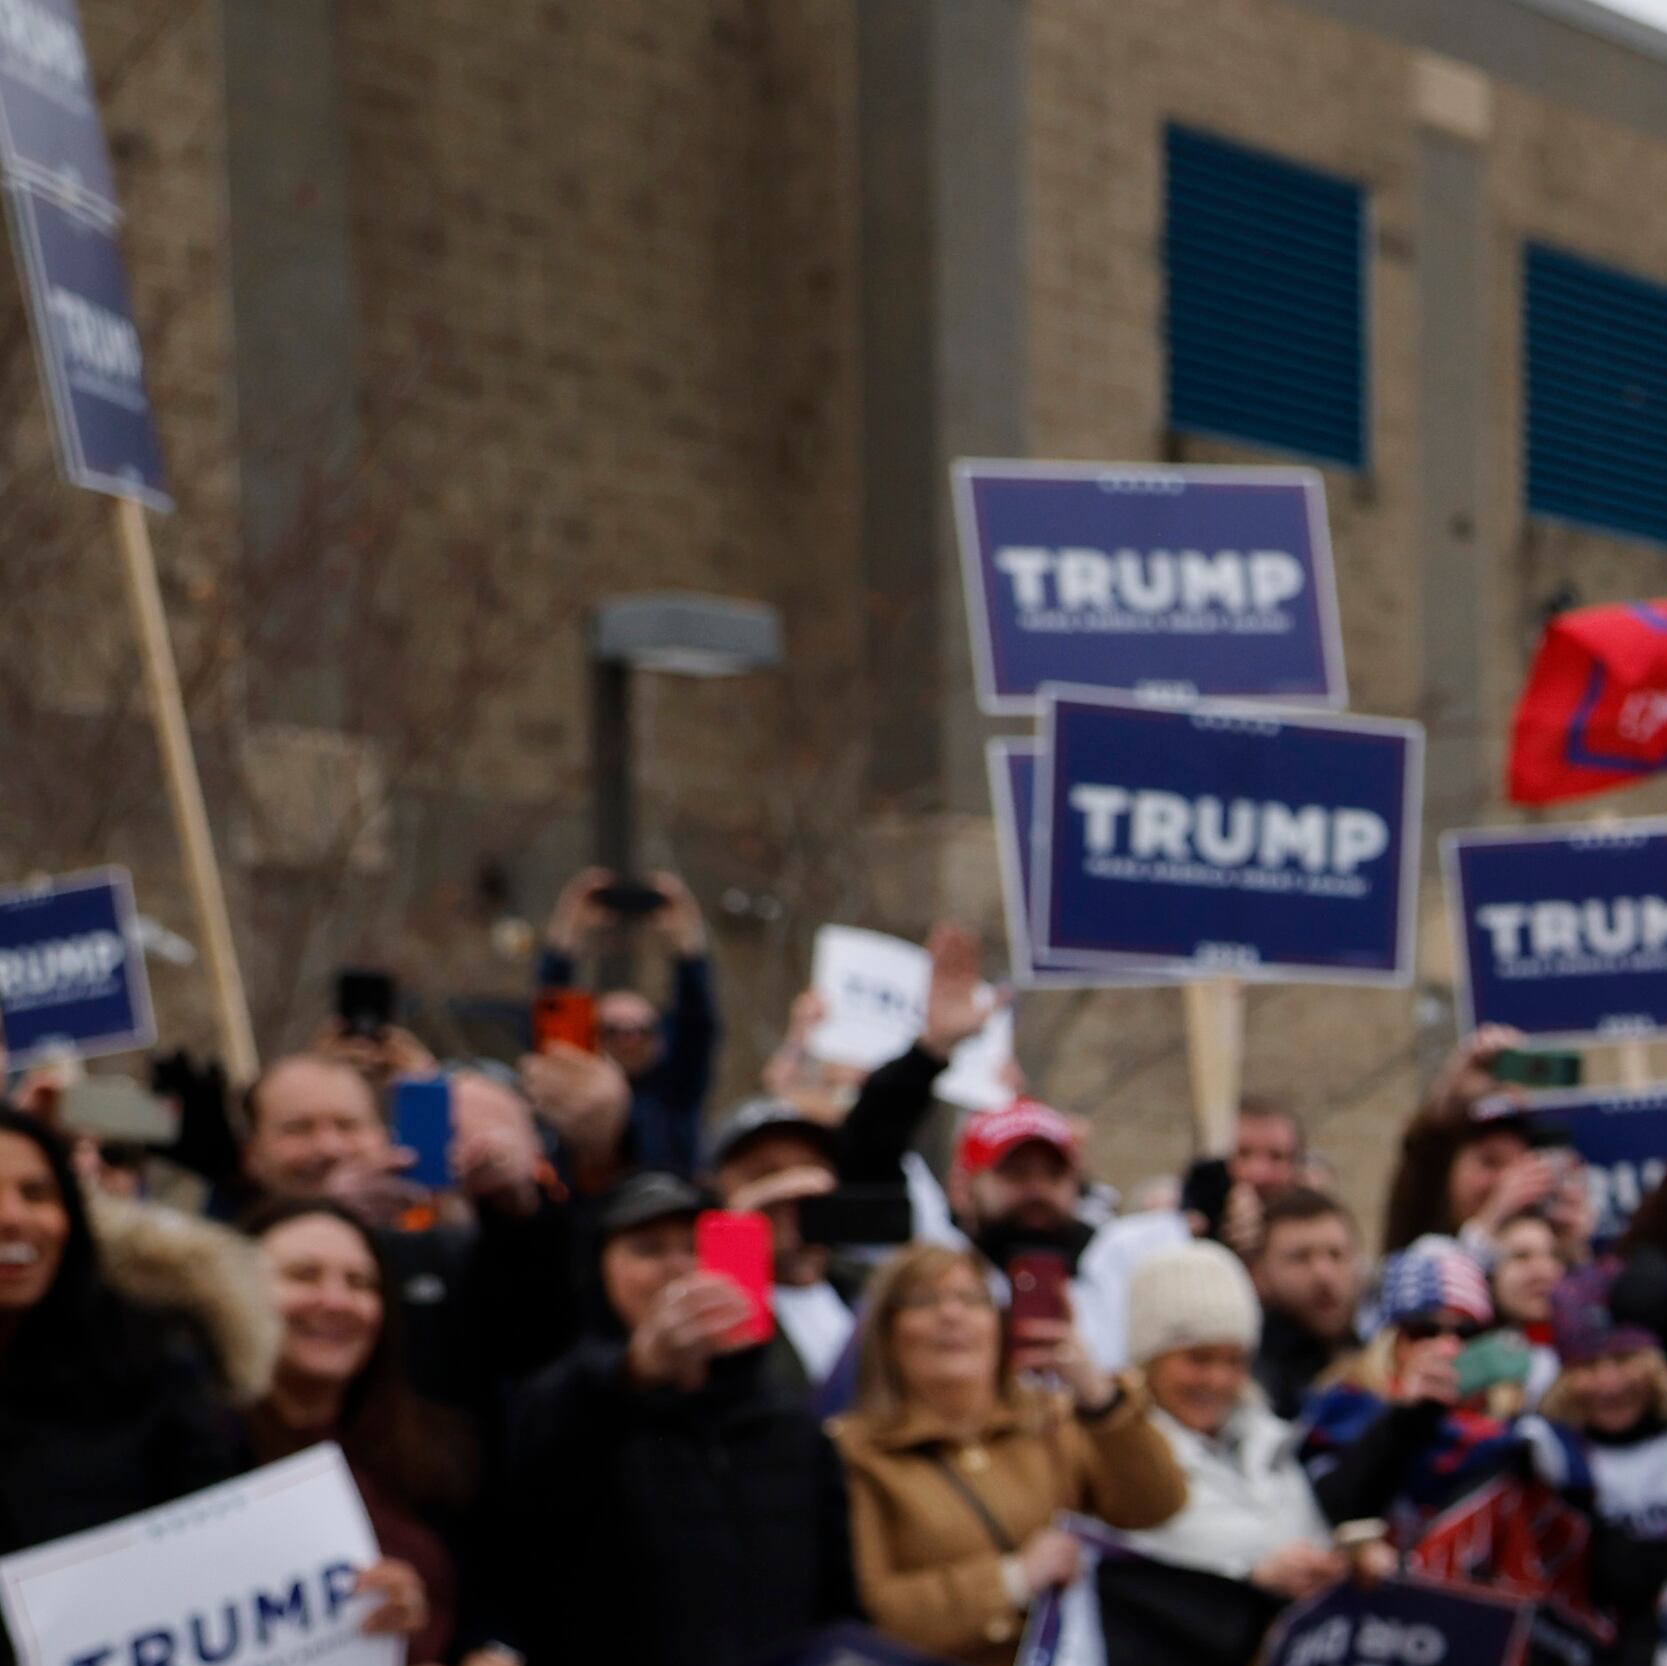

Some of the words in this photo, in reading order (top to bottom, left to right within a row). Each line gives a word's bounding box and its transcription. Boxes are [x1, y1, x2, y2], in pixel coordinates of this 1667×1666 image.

[994, 544, 1306, 614] TRUMP
[1068, 784, 1390, 875] TRUMP
[0, 930, 124, 996] RUMP
